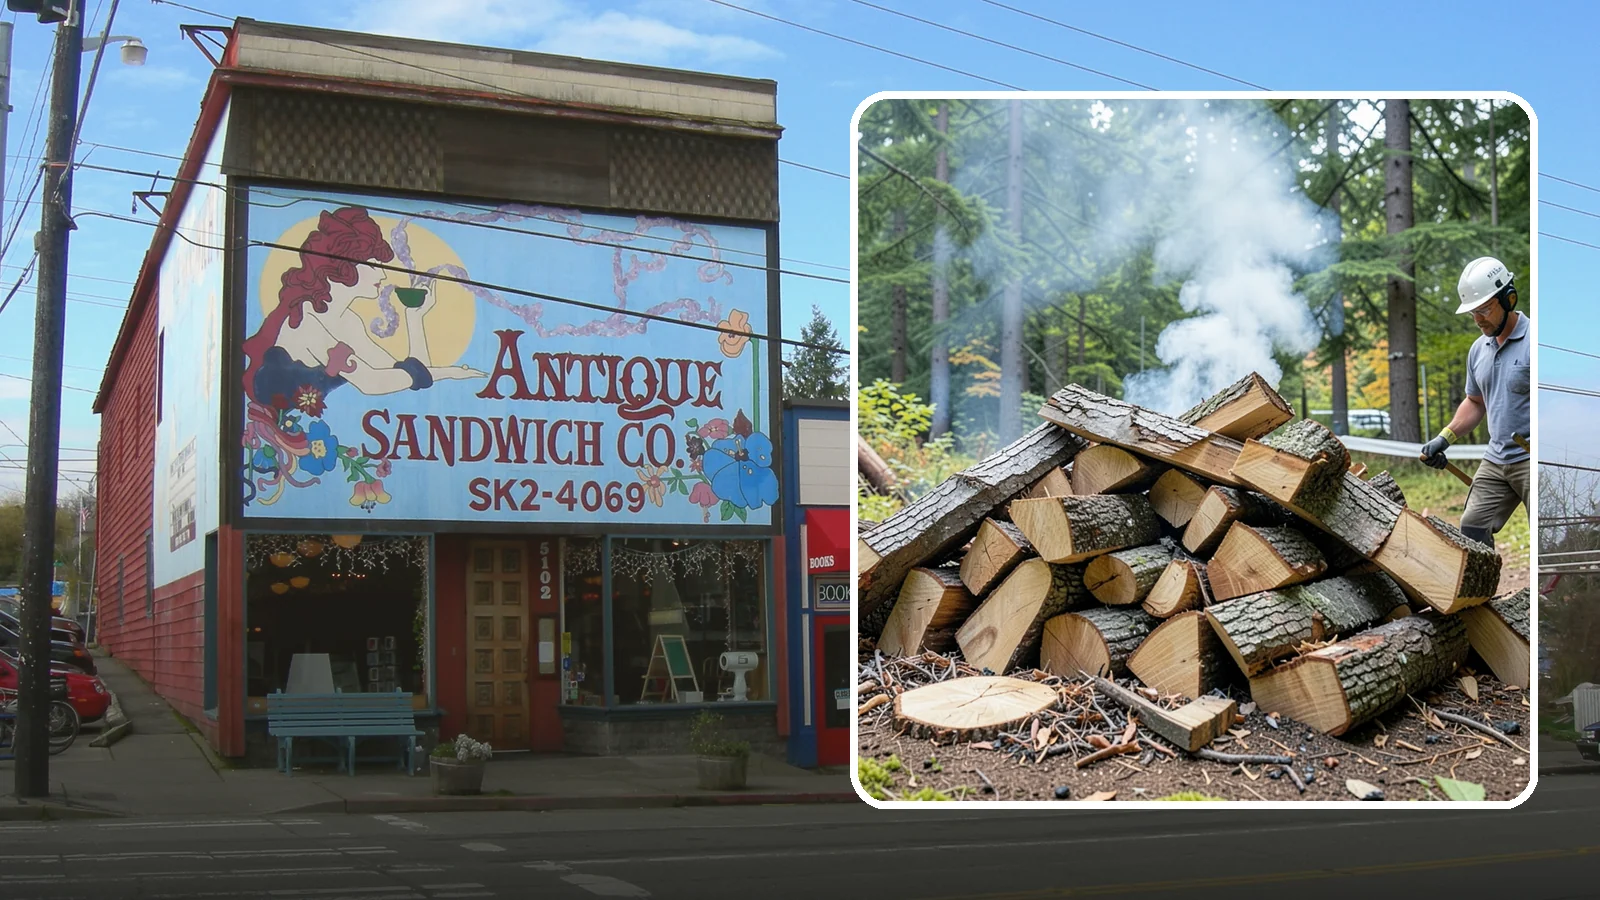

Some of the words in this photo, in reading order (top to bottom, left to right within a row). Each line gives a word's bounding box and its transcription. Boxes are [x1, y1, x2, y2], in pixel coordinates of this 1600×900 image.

[477, 330, 723, 421] ANTIQUE
[361, 408, 604, 467] SANDWICH
[617, 421, 684, 469] CO.
[468, 477, 646, 513] SK2-4069
[540, 541, 551, 600] 5102
[809, 555, 835, 569] BOOKS
